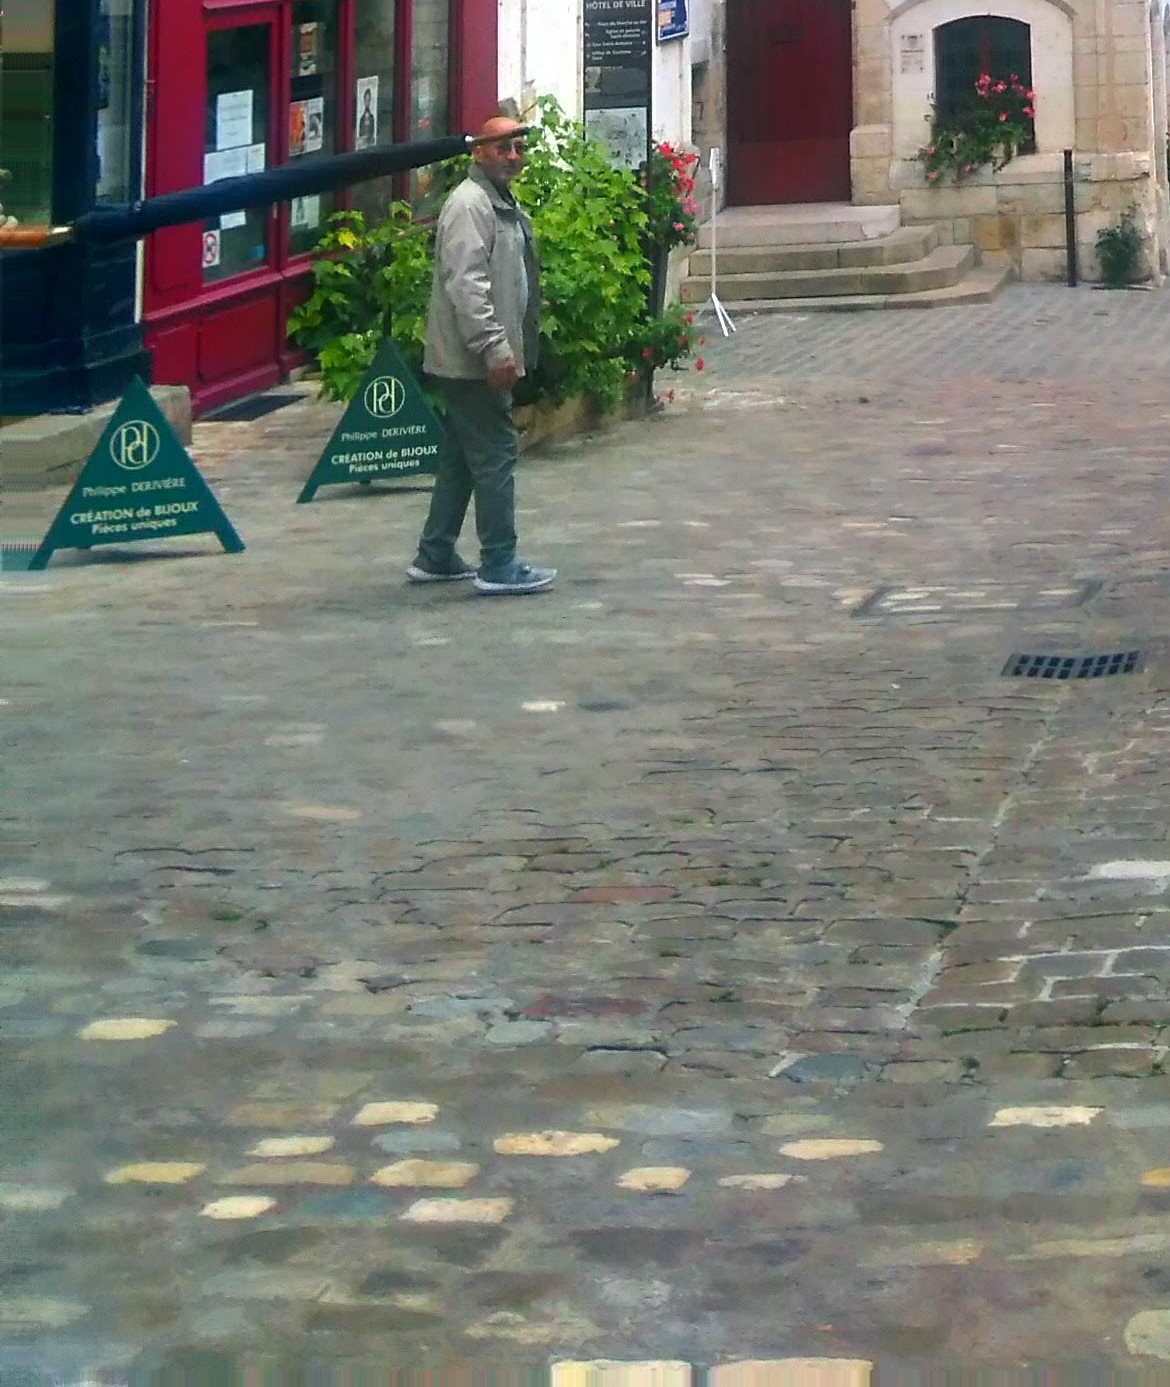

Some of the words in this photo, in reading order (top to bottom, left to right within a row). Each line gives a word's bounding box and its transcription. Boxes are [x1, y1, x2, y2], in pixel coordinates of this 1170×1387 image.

[585, 0, 611, 10] HÔTEL
[613, 0, 624, 8] DE
[625, 0, 646, 7] VILLE
[341, 431, 378, 442] Philippe
[331, 450, 383, 465] CRÉATION
[385, 449, 398, 458] de
[401, 445, 438, 457] BIJOUX
[381, 459, 420, 470] uniques
[82, 486, 127, 497] Philippe
[70, 508, 133, 524] CRÉATION
[136, 507, 151, 518] de
[154, 501, 199, 515] BIJOUX
[131, 518, 177, 530] uniques
